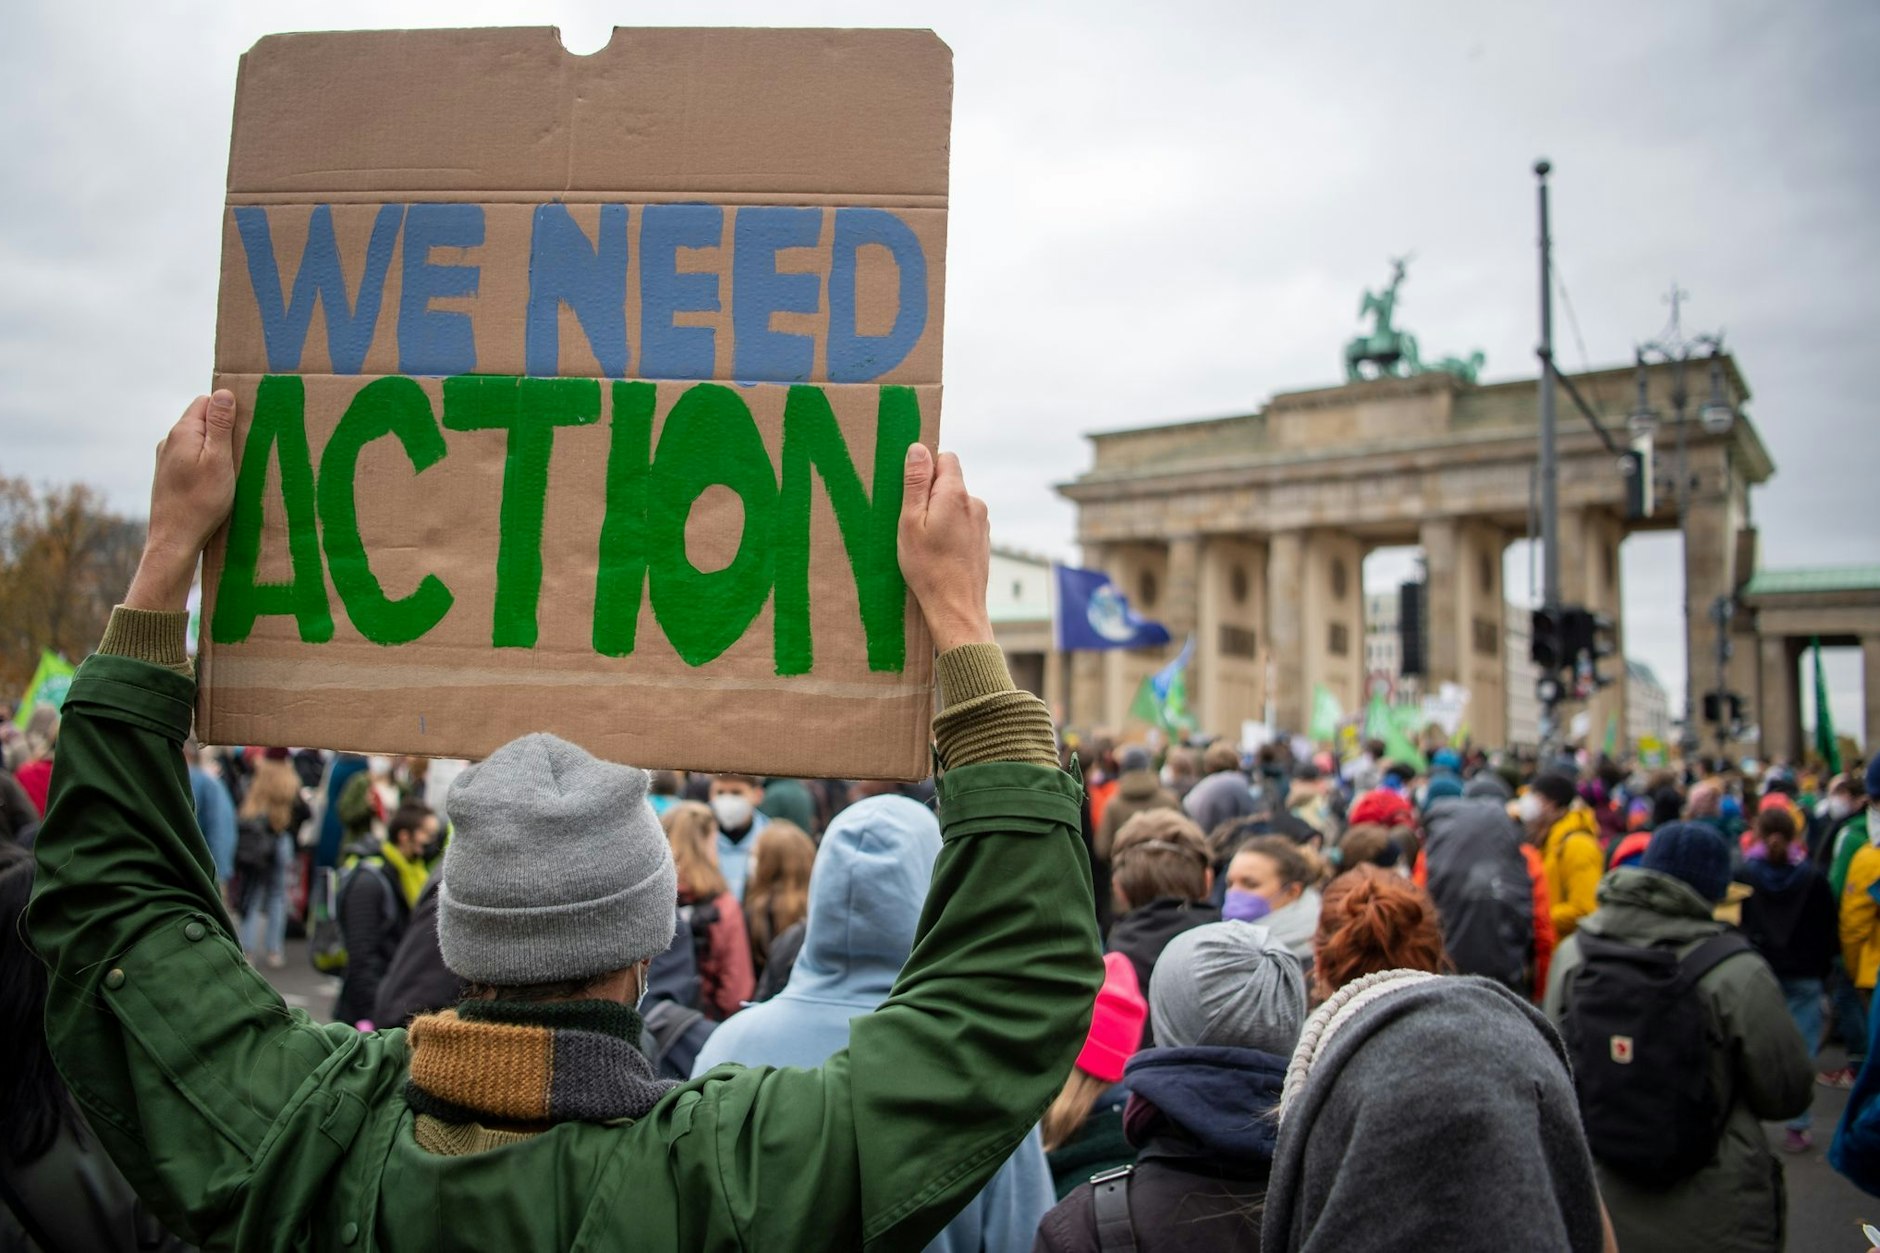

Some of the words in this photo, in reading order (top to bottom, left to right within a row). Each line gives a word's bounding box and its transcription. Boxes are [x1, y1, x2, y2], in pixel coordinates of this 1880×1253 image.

[235, 202, 485, 377] WE
[527, 199, 928, 386] NEED
[212, 373, 921, 676] ACTION
